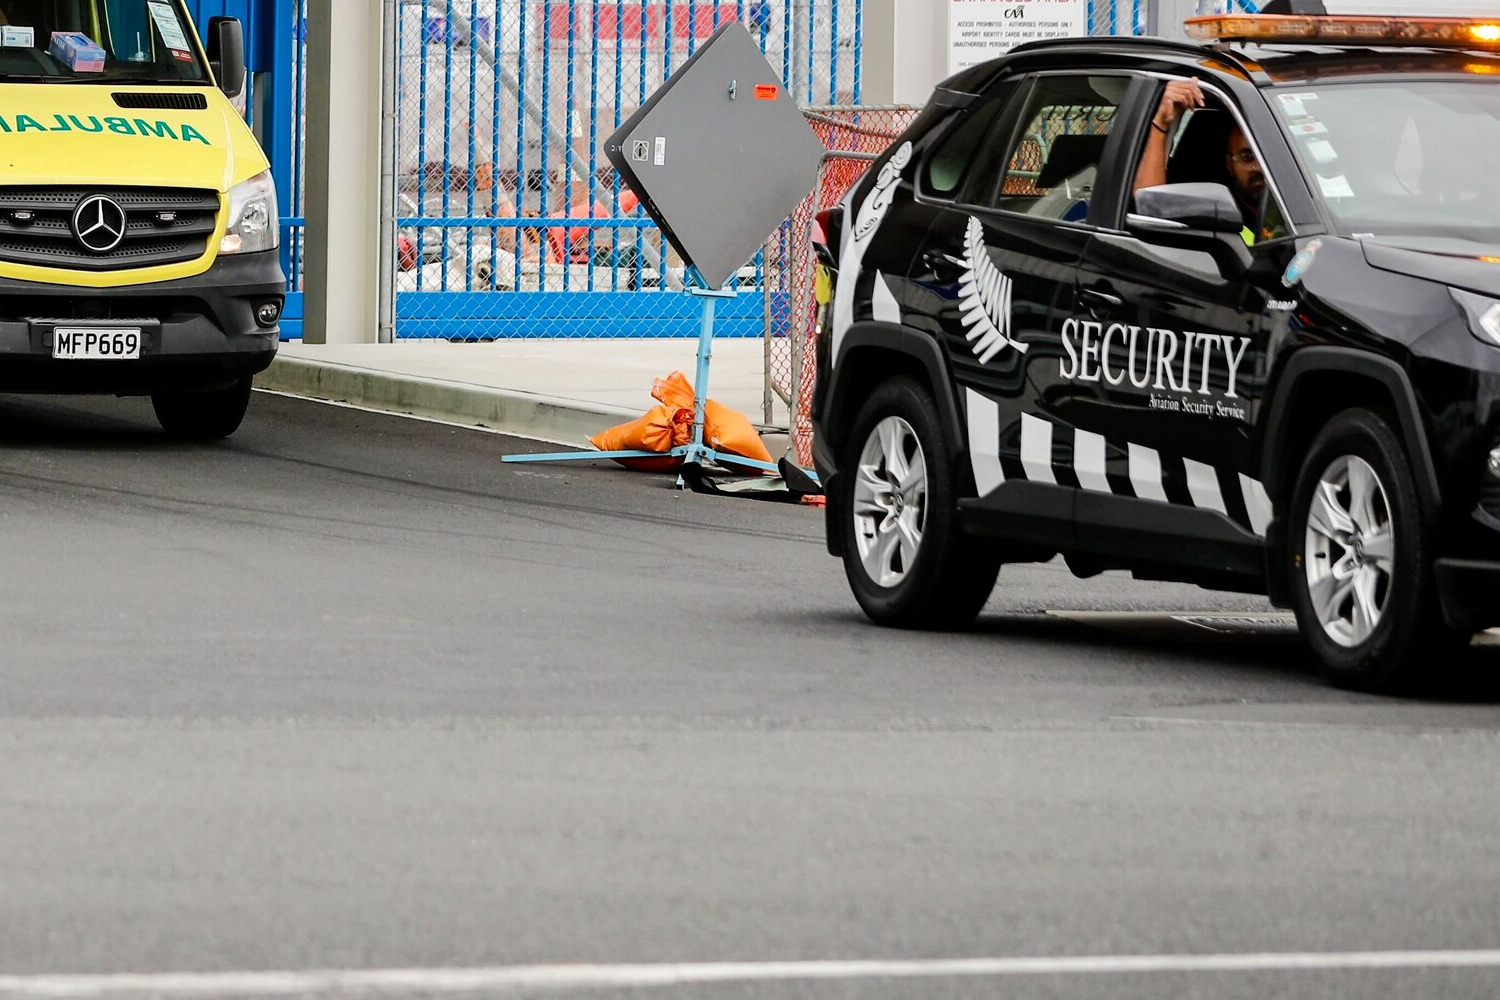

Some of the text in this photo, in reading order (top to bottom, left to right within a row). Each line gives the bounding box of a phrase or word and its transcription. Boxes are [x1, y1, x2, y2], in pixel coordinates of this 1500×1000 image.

[57, 333, 137, 354] MFP669
[1059, 317, 1251, 398] SECURITY
[1149, 393, 1245, 420] Aviation Security Service
